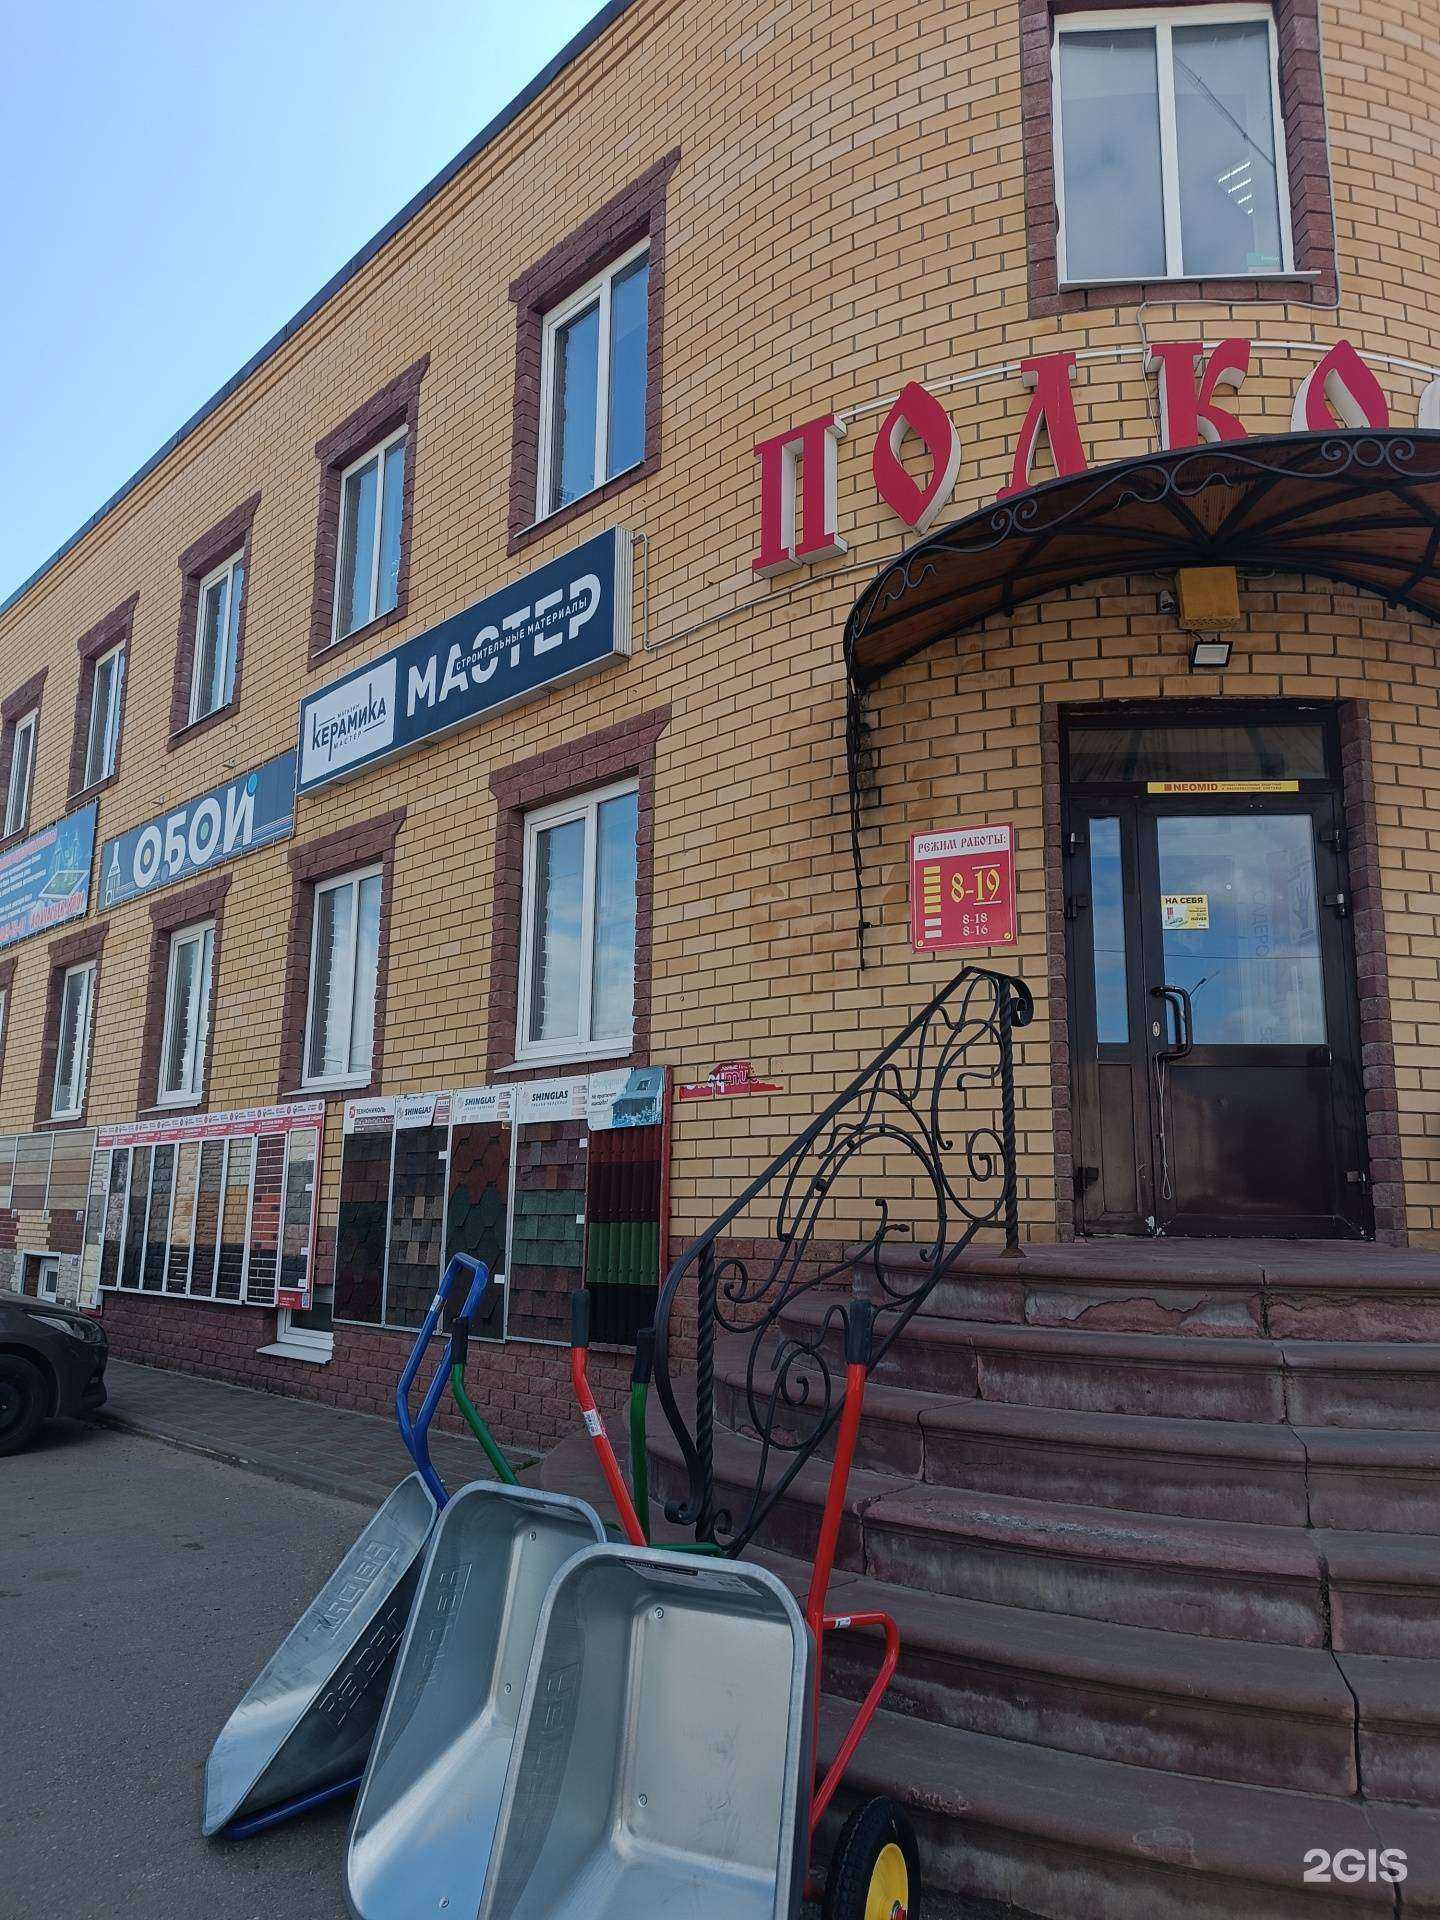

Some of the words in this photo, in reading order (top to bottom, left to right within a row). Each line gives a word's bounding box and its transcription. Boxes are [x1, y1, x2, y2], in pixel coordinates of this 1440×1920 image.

[752, 339, 1440, 578] ПОЛКО
[406, 573, 601, 718] МАСТЕР
[455, 632, 525, 671] СТРОИТЕЛЬНЫЕ
[527, 597, 587, 634] МАТЕРИАЛЫ
[312, 683, 387, 762] КЕРАМИКА
[1173, 783, 1218, 792] NEOMID
[951, 868, 1000, 903] 8-19
[962, 912, 989, 925] 8-18
[464, 1095, 496, 1106] SHINGLAS
[531, 1090, 569, 1102] SHINGLAS
[404, 1105, 432, 1116] SHINGLAS
